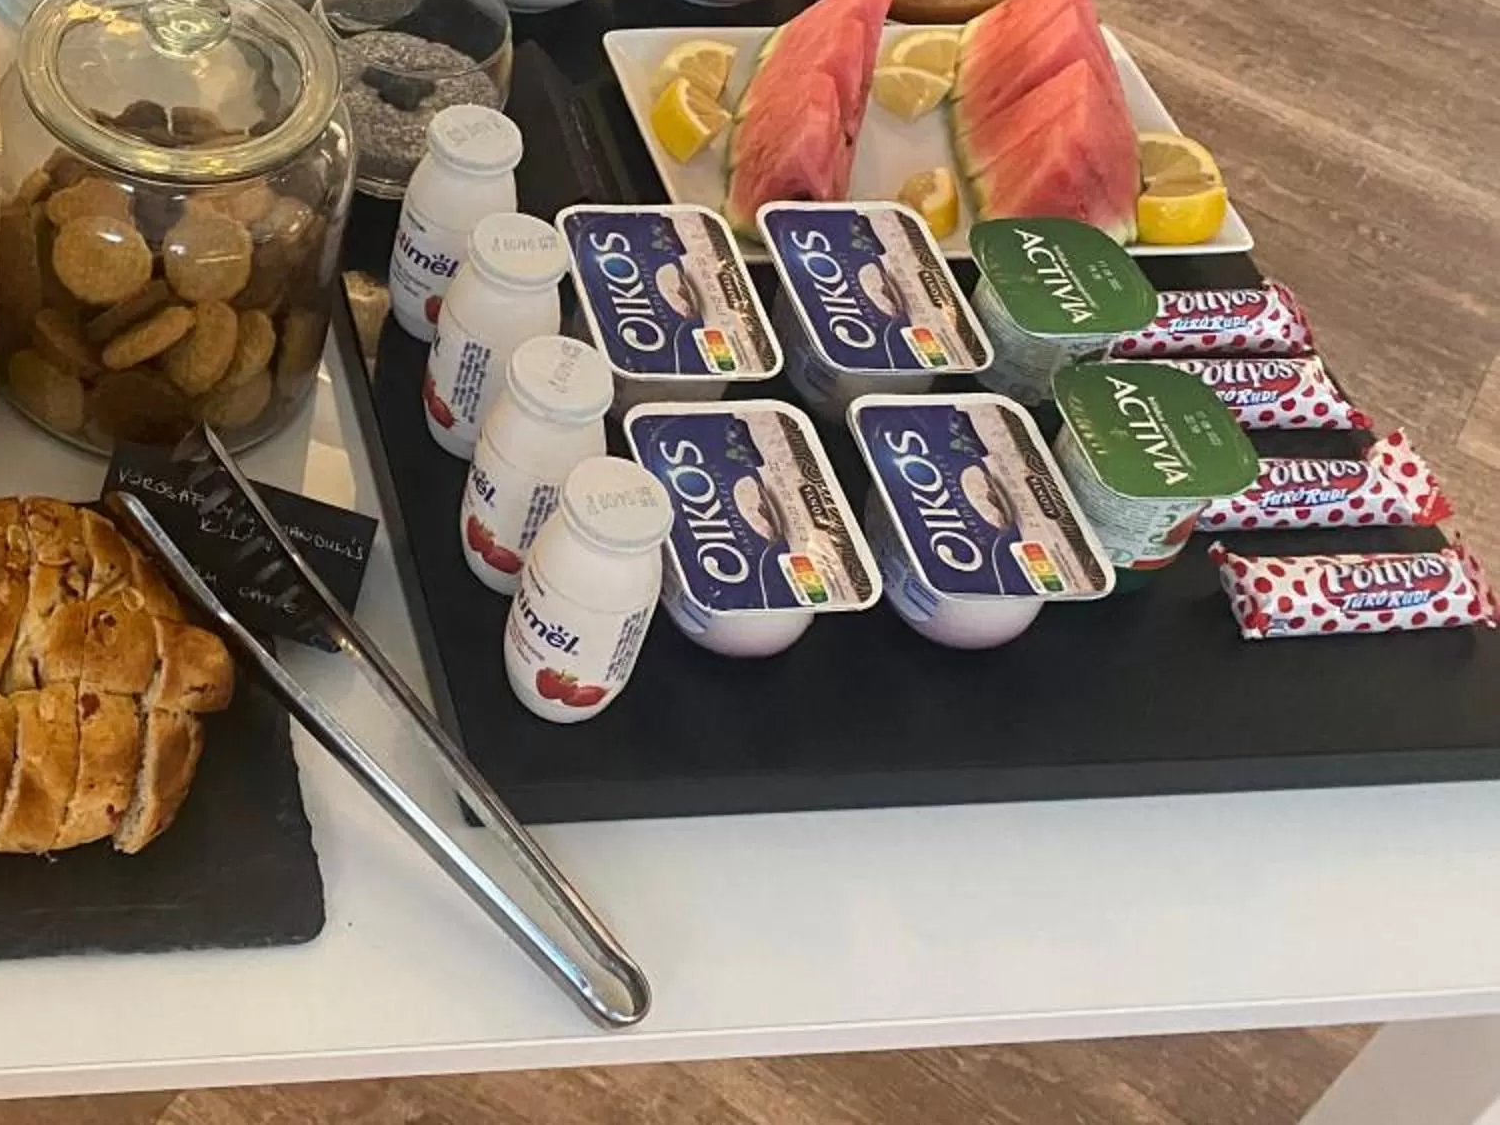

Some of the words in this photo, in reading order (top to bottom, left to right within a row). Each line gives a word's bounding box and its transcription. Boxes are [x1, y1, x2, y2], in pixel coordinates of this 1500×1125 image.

[589, 232, 666, 351] OIKOS
[791, 230, 876, 349] OIKOS
[1012, 228, 1093, 324] ACTIVIA
[1105, 376, 1189, 485] ACTIVIA
[659, 439, 749, 583] OIKOS
[884, 429, 983, 572] OIKOS
